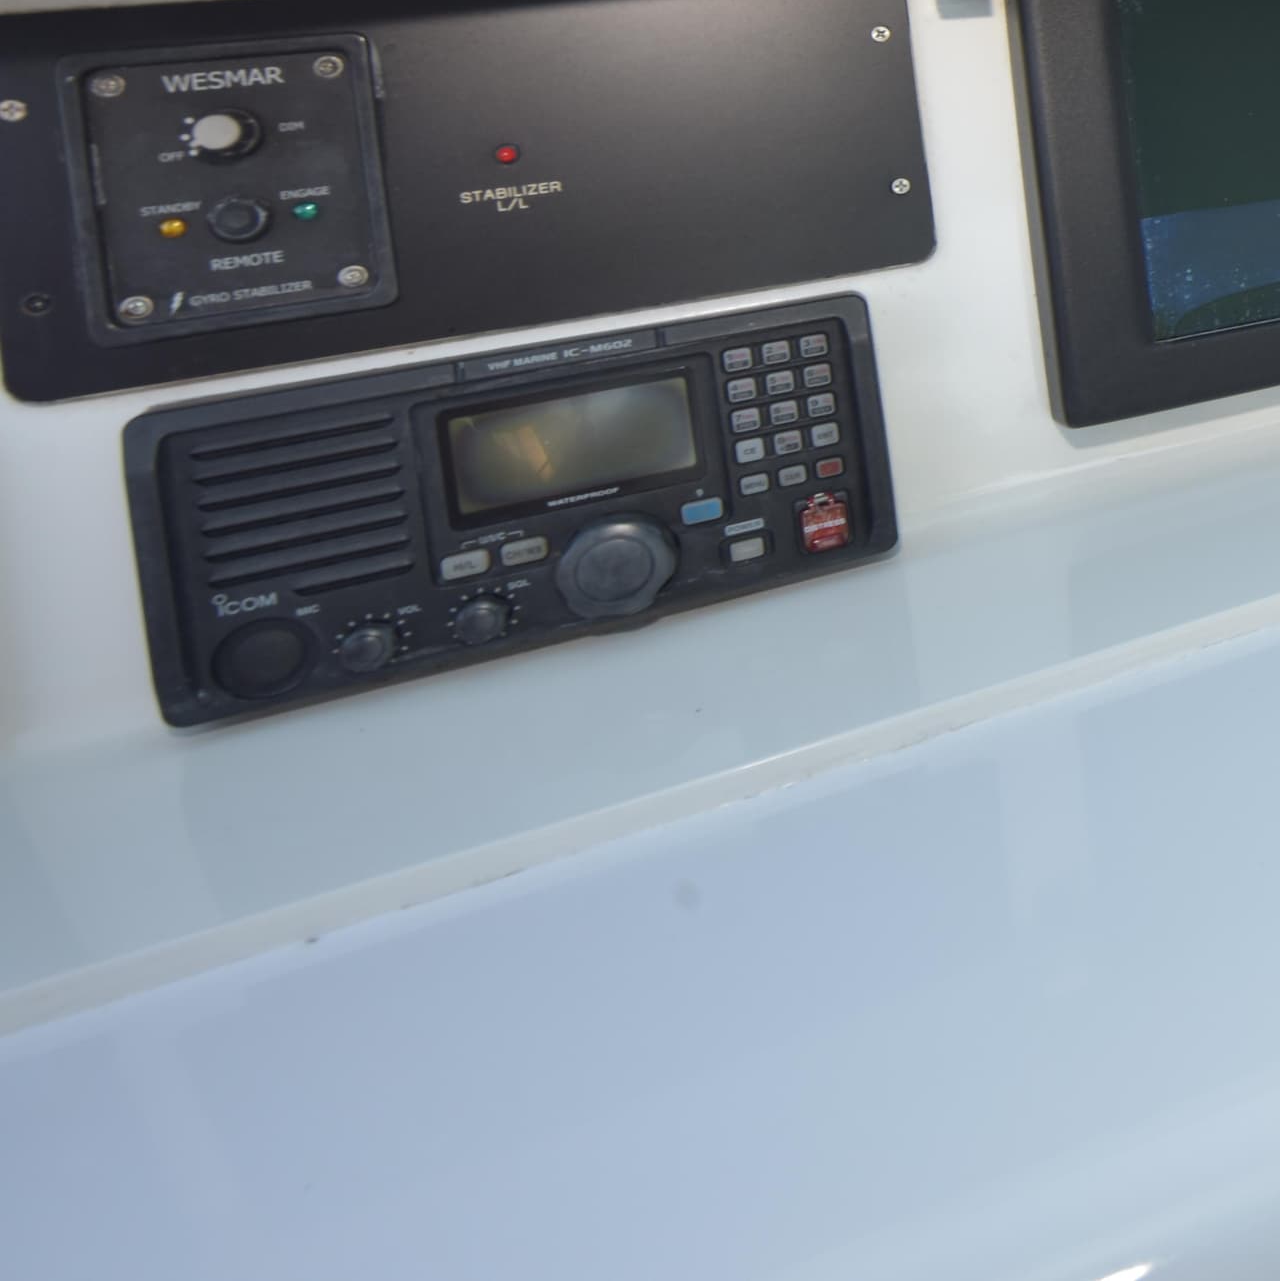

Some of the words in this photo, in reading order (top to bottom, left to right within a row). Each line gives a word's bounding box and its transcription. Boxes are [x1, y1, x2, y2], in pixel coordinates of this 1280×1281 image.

[161, 66, 285, 94] WESMAR
[158, 150, 184, 163] OFF
[280, 185, 331, 201] ENGAGE
[459, 180, 563, 204] STABILIZER
[140, 201, 202, 217] STANDBY
[496, 198, 529, 212] L/L
[210, 250, 285, 272] REMOTE
[190, 290, 230, 307] GYRO
[233, 280, 313, 301] STABILIZER
[488, 359, 511, 371] VHF
[513, 352, 558, 367] MARINE
[563, 339, 632, 358] IC-M602
[547, 487, 620, 507] WATERPROOF
